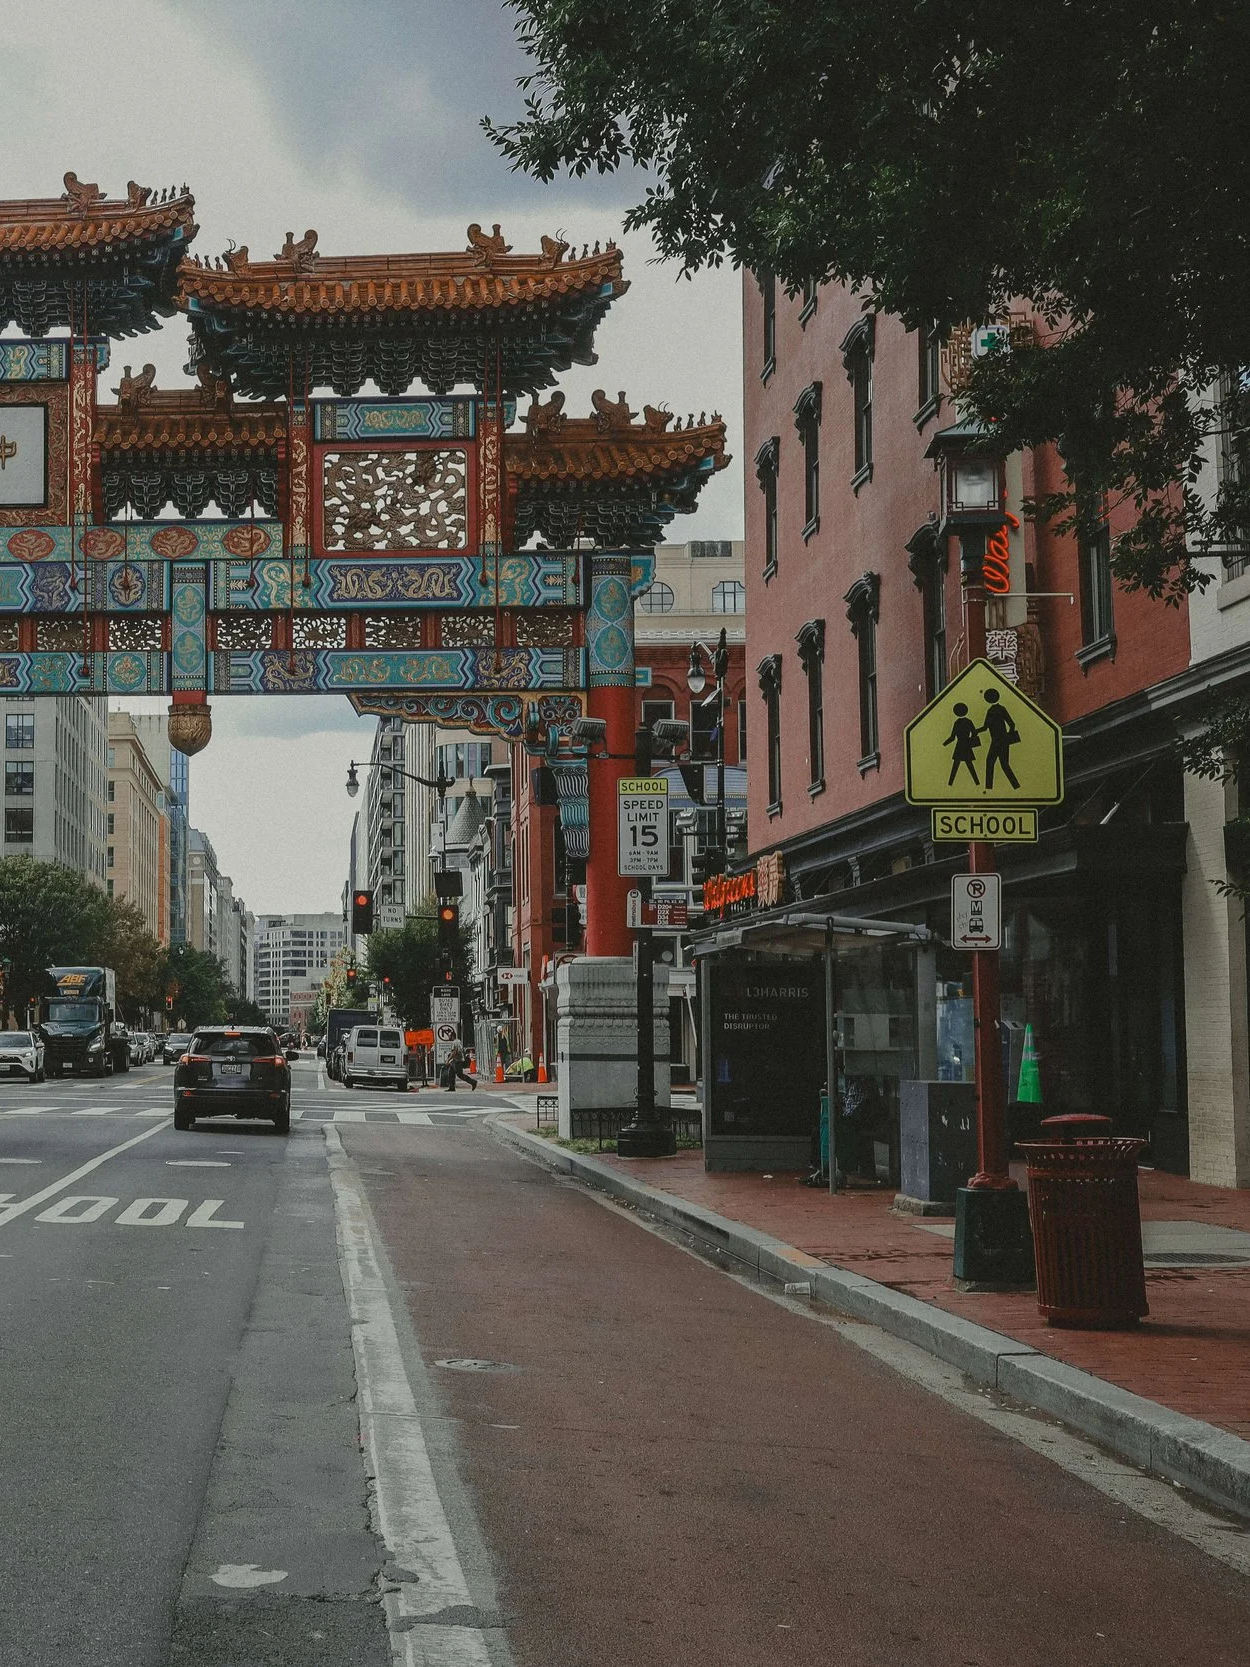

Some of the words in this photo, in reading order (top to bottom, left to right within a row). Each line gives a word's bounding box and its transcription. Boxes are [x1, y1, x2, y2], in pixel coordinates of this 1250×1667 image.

[621, 782, 666, 792] SCHOOL
[623, 800, 664, 810] SPEED
[627, 813, 660, 822] LIMIT
[940, 815, 1031, 835] SCHOOL
[629, 825, 659, 847] 15
[60, 974, 88, 983] ABF
[746, 986, 810, 998] L3HARRIS
[723, 1012, 739, 1020] THE
[741, 1012, 778, 1021] TRUSTED
